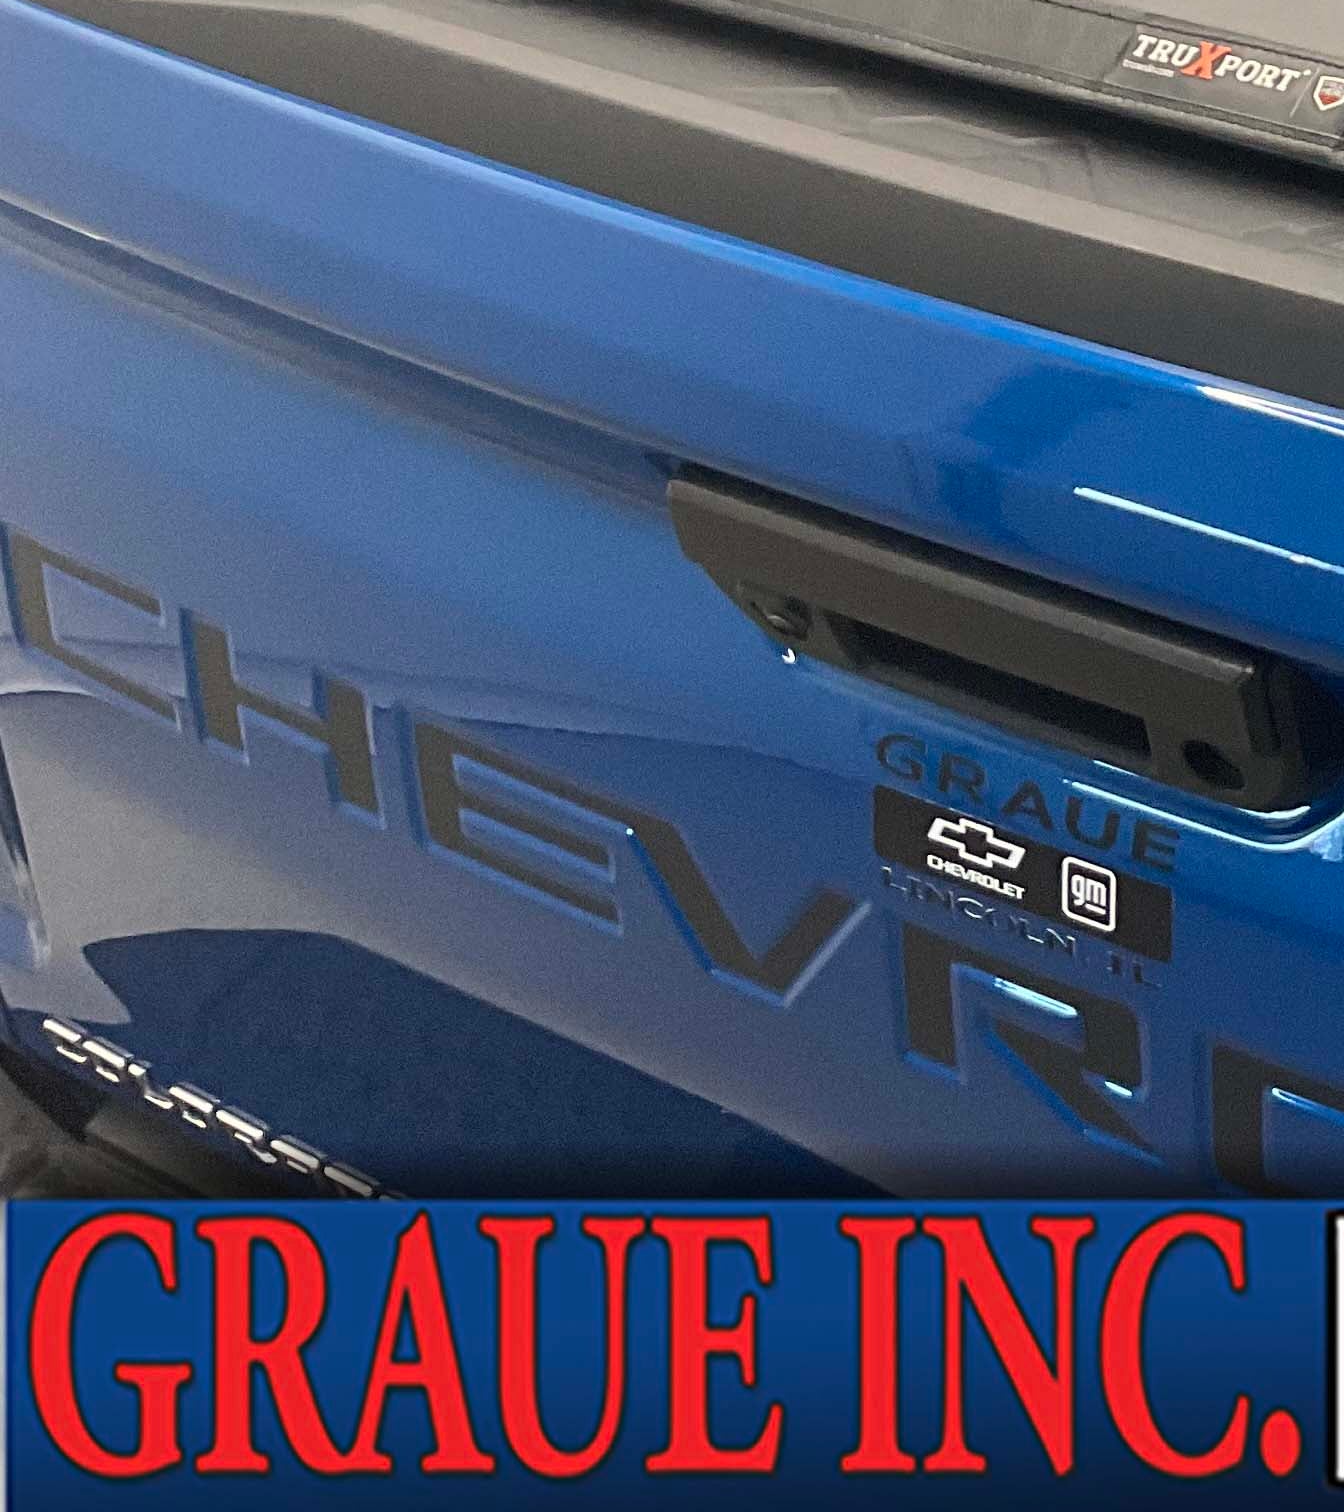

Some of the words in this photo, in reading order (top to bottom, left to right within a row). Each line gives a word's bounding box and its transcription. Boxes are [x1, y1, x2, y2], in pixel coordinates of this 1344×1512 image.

[1132, 34, 1304, 92] TRUXPORT
[876, 733, 1182, 872] GRAUE
[926, 854, 1025, 900] CHEVROLET
